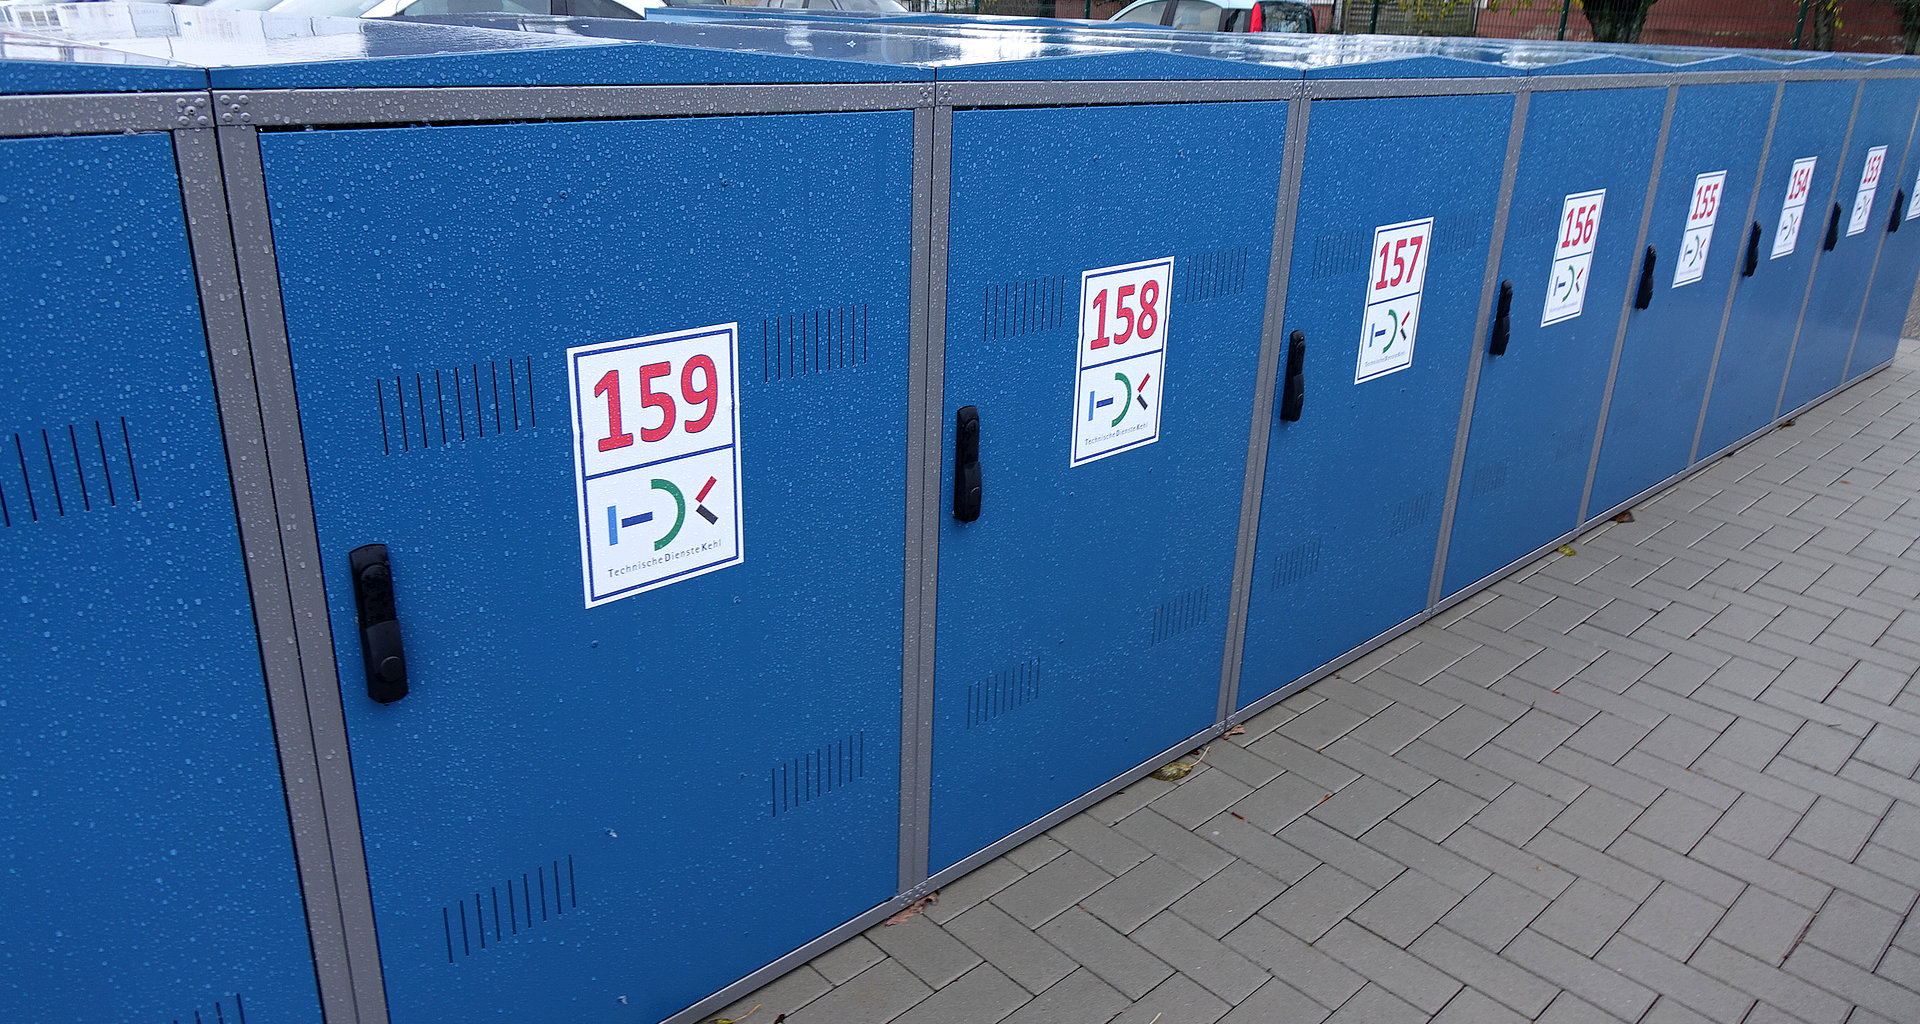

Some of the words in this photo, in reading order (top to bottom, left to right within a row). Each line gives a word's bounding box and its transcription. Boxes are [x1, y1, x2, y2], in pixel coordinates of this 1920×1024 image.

[1561, 203, 1597, 248] 156
[1691, 183, 1719, 220] 155
[1375, 235, 1423, 290] 157
[1090, 279, 1160, 350] 158
[593, 353, 718, 453] 159
